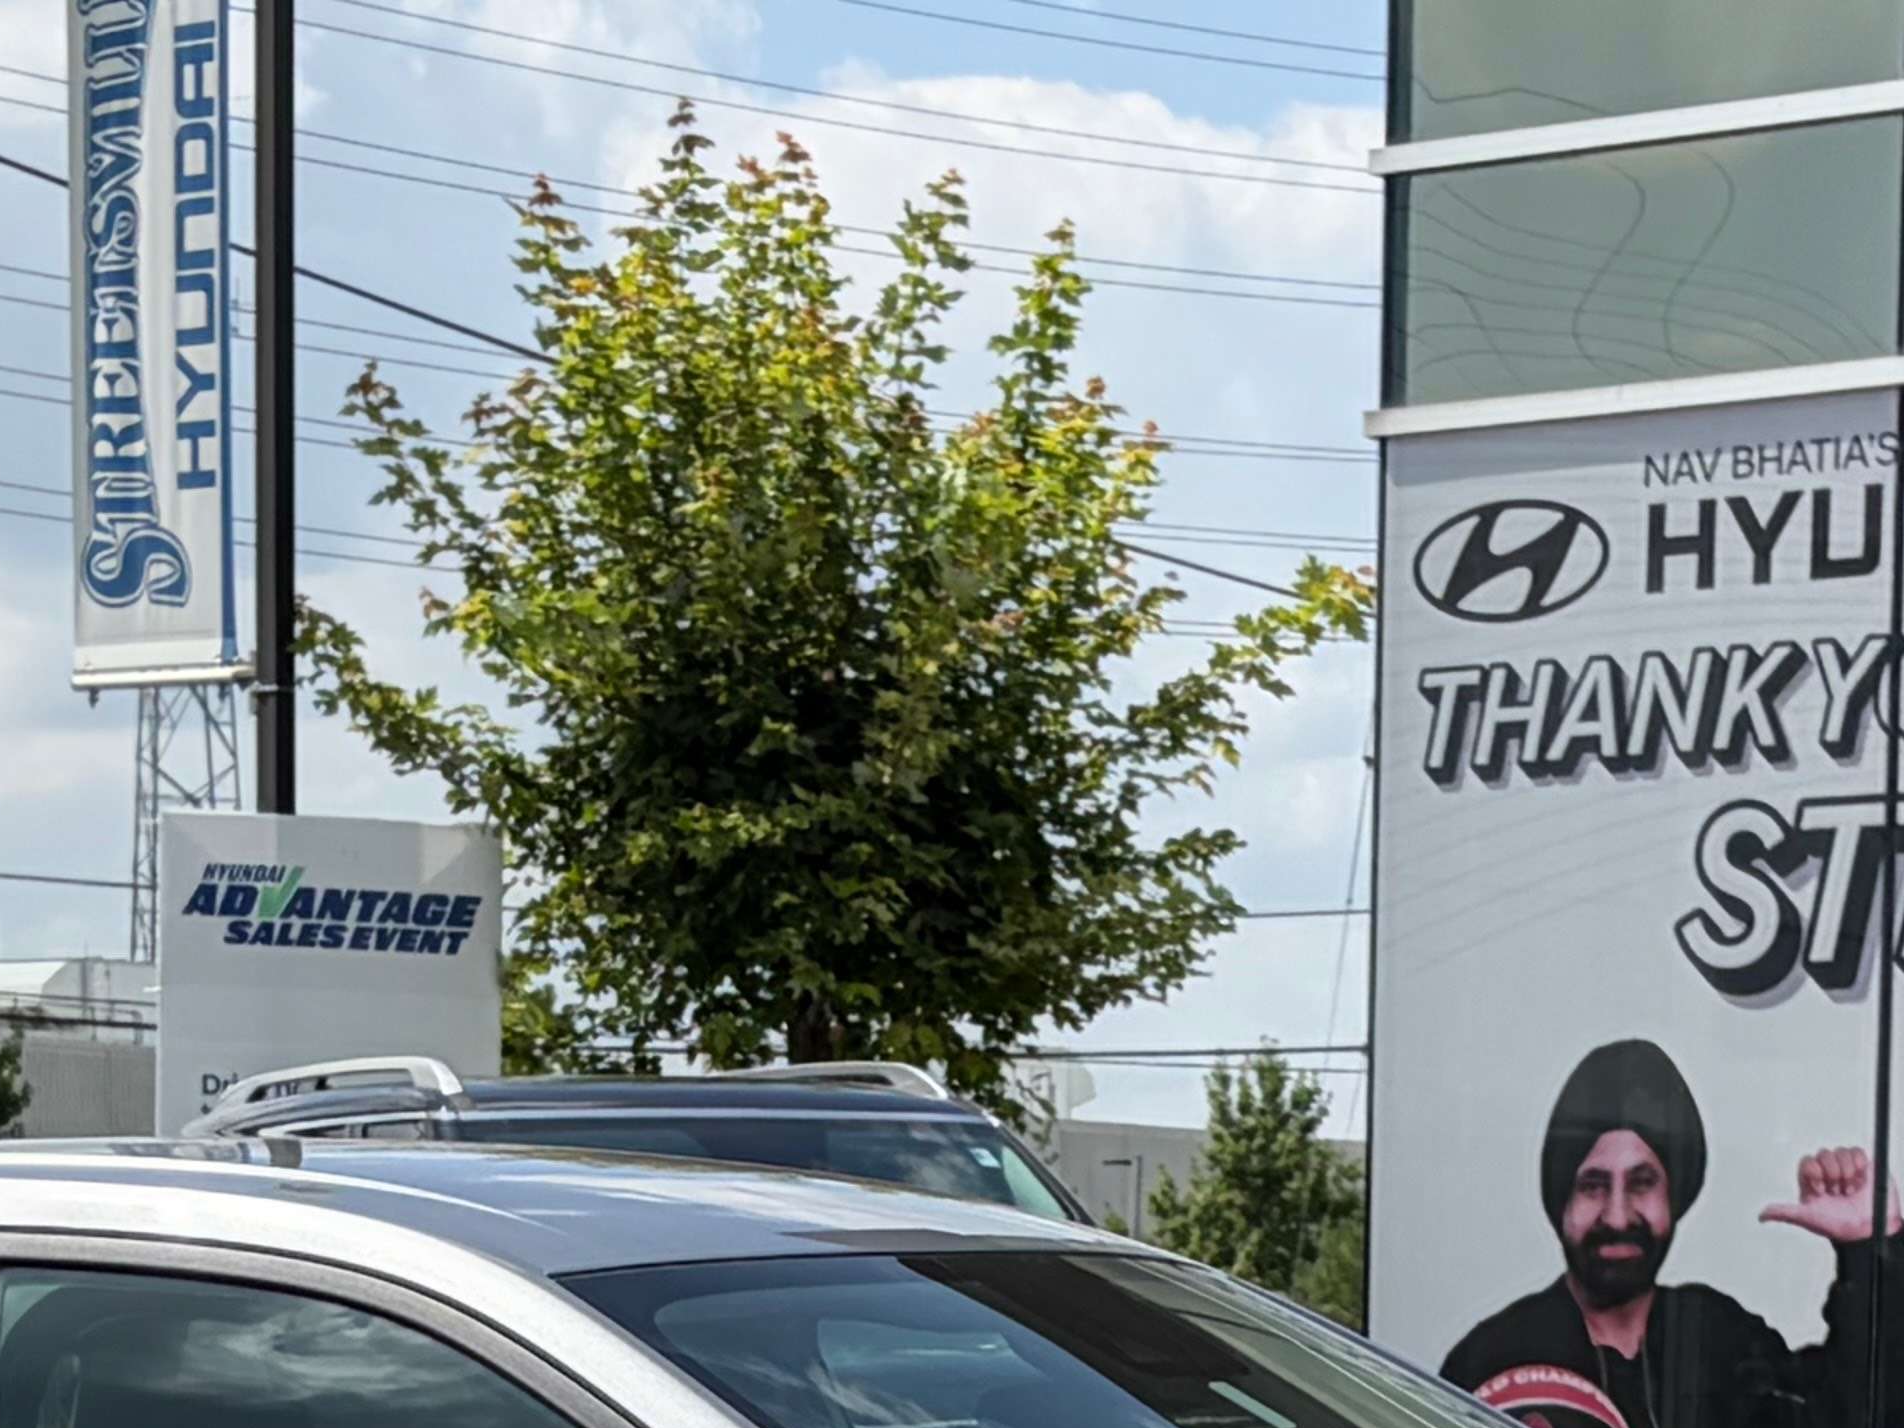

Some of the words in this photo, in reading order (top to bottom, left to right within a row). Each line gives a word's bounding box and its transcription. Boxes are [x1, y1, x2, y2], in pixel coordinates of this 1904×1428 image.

[173, 20, 216, 490] HYUNDAI
[1642, 450, 1722, 488] NAV
[1731, 431, 1900, 480] BHATIA'S
[1418, 640, 1808, 788] THANK
[182, 868, 483, 929] ADVANTAGE
[202, 863, 286, 883] HYUNDAI
[223, 919, 348, 950] SALES
[348, 925, 471, 956] EVENT
